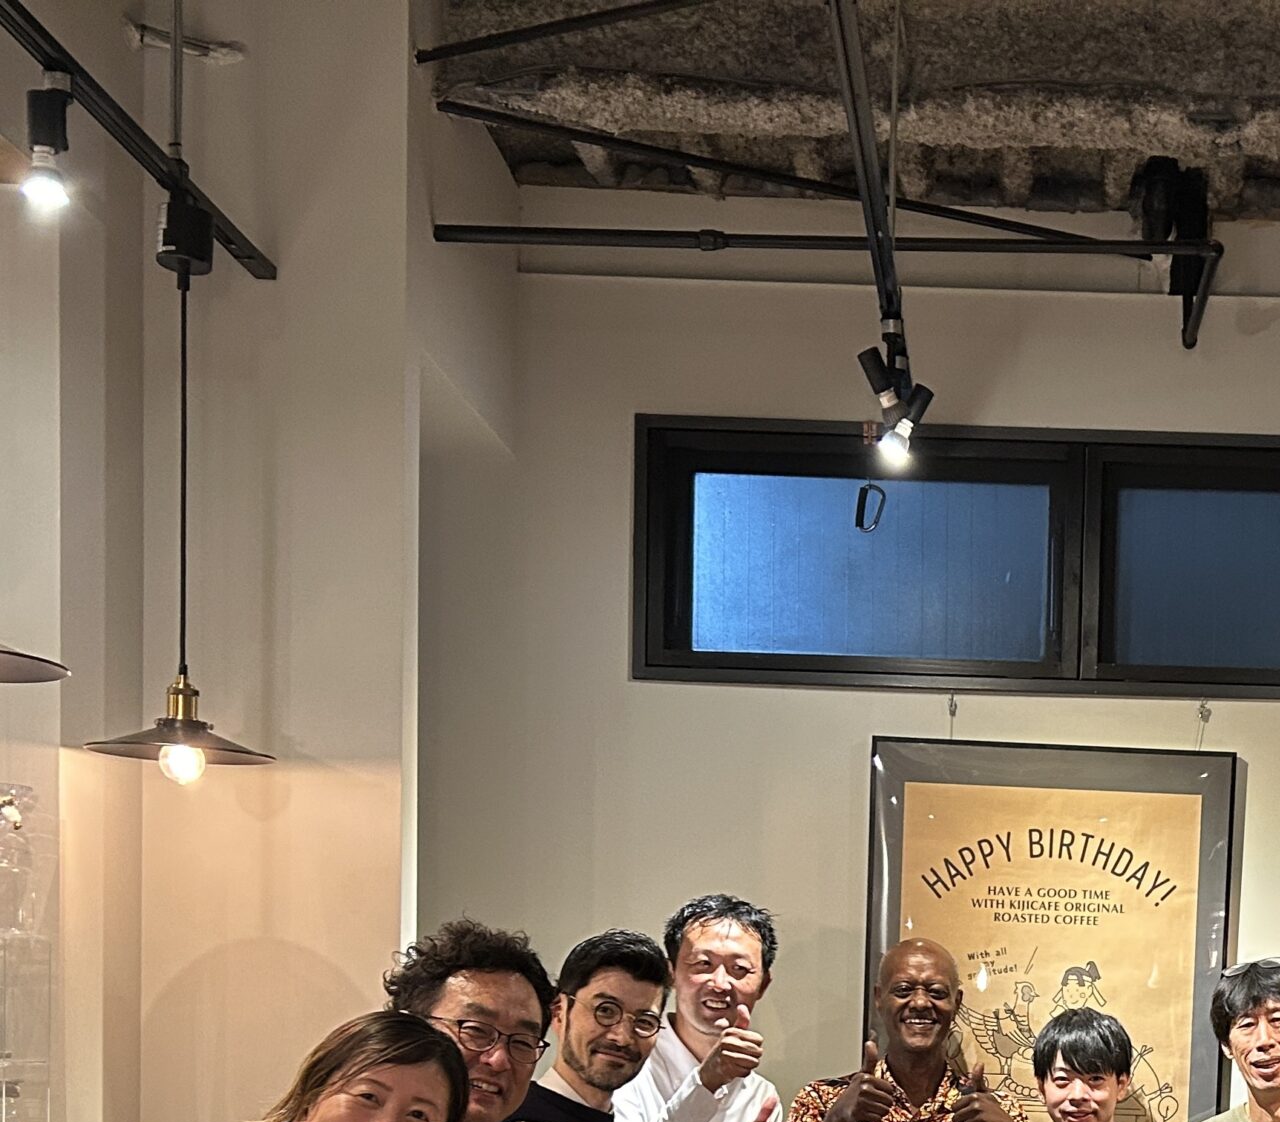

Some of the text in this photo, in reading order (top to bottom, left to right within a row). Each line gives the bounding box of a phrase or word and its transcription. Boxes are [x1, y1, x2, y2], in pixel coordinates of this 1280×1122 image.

[921, 828, 1177, 907] HAPPY BIRTHDAY!
[987, 885, 1111, 900] HAVE A GOOD TIME
[971, 898, 1125, 914] WITH KIJICAFE ORIGINAL
[993, 912, 1099, 926] ROASTED COFFEE
[967, 946, 1007, 961] With all
[967, 964, 1018, 980] gritude!
